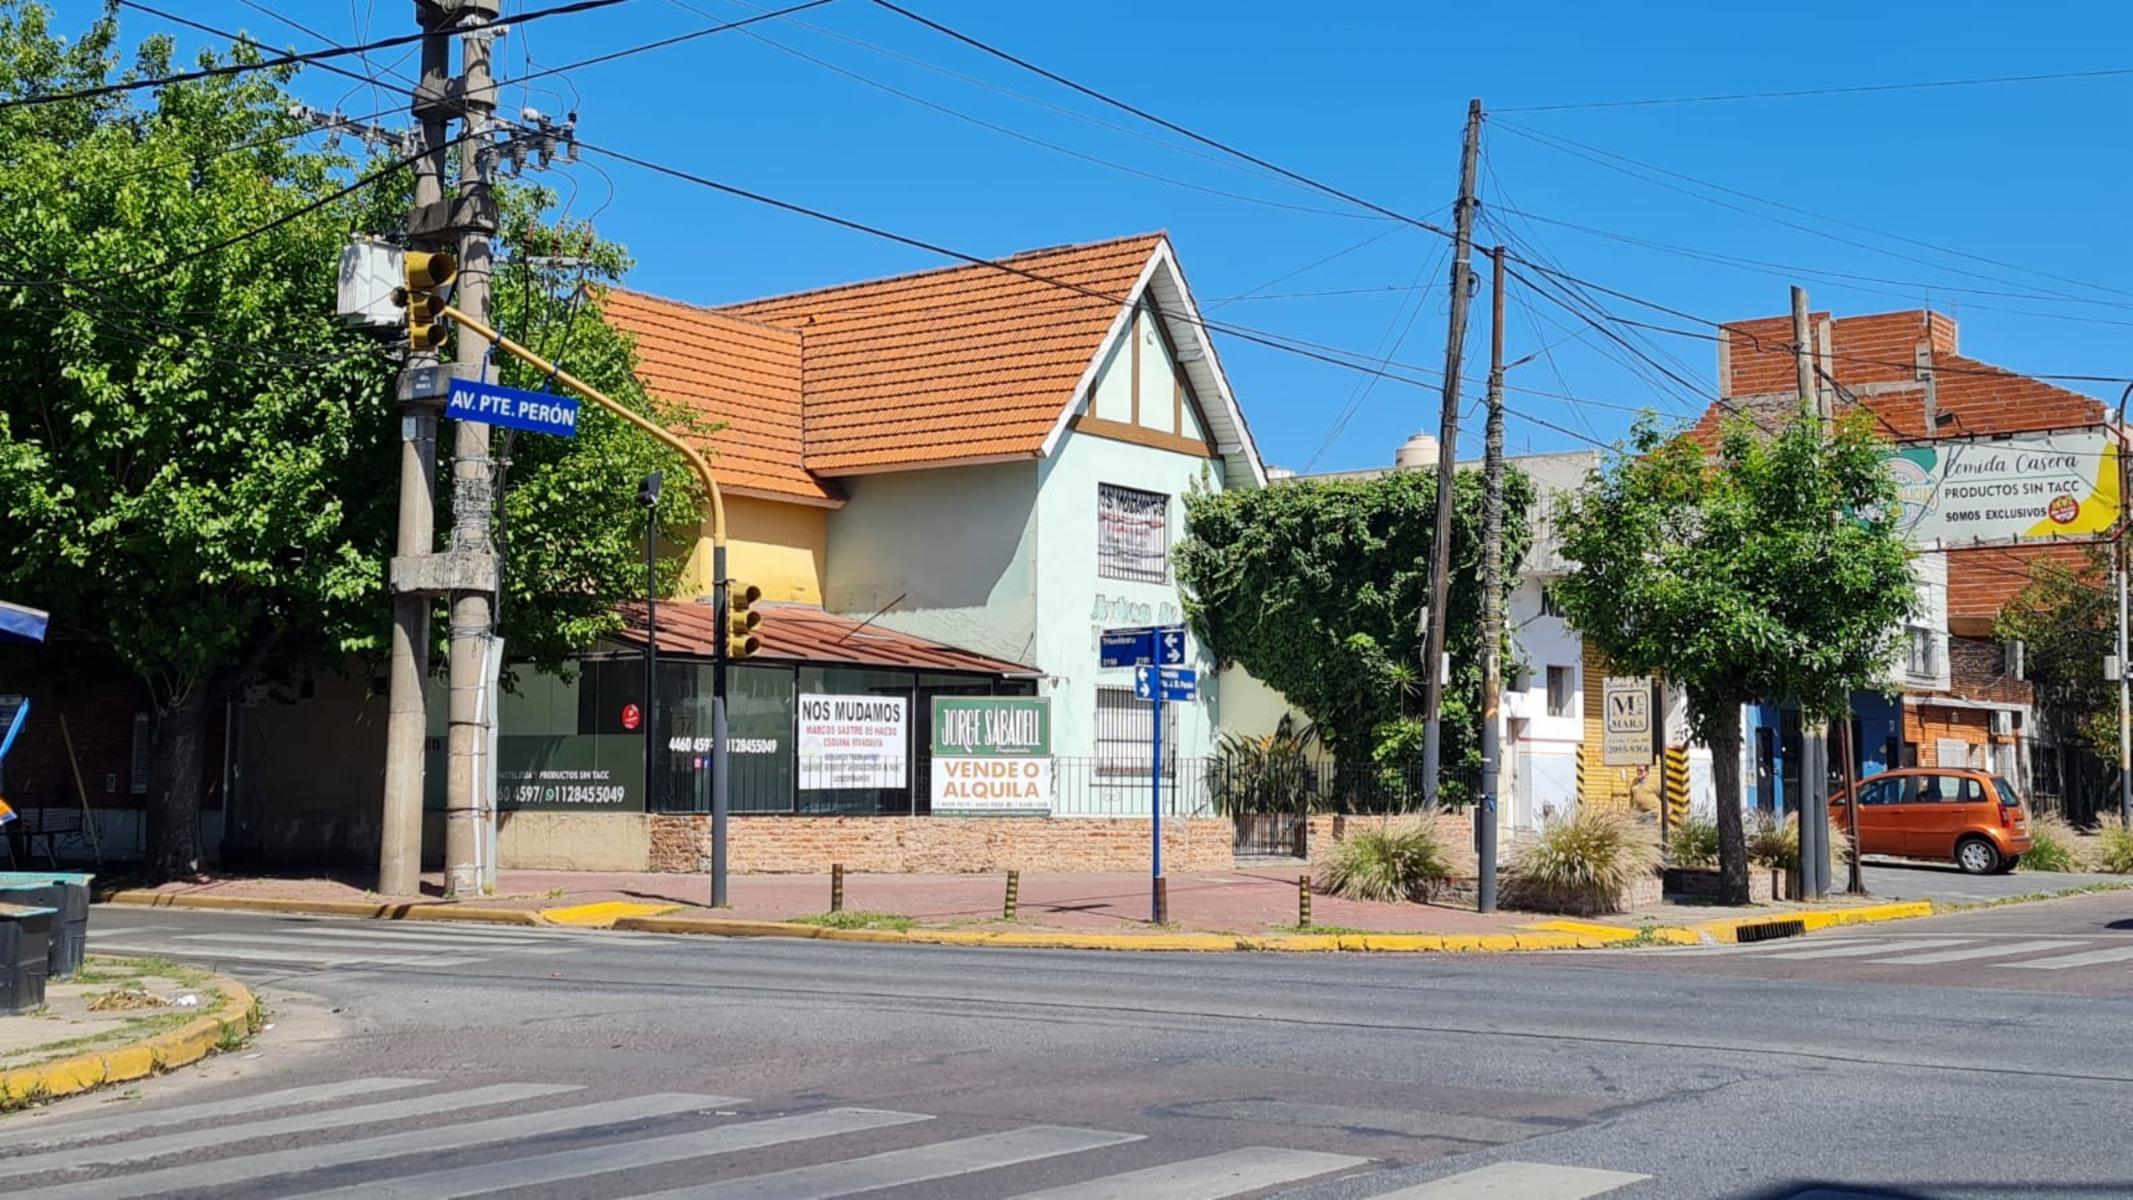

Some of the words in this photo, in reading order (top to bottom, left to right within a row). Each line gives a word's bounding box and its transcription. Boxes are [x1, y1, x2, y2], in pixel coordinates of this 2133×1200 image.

[450, 390, 476, 410] AV.
[480, 394, 515, 417] PTE.
[518, 402, 575, 426] PERÓN
[2016, 453, 2080, 474] Casera
[1945, 483, 2019, 499] PRODUCTOS
[2023, 482, 2043, 494] SIN
[2048, 480, 2080, 492] TACC
[1945, 511, 1981, 522] SOMOS
[1986, 507, 2047, 520] EXCLUSIVOS
[802, 701, 830, 721] NOS
[835, 701, 901, 723] MUDAMOS
[941, 709, 982, 753] JORGE
[984, 704, 1041, 745] SABADELL
[668, 737, 692, 752] 4460
[539, 770, 578, 780] PRODUCTOS
[580, 771, 591, 780] SIN
[592, 770, 611, 780] TACC
[944, 761, 1018, 778] VENDE
[1023, 761, 1040, 778] O
[554, 786, 625, 803] 1128455049
[943, 781, 1040, 799] ALQUILA
